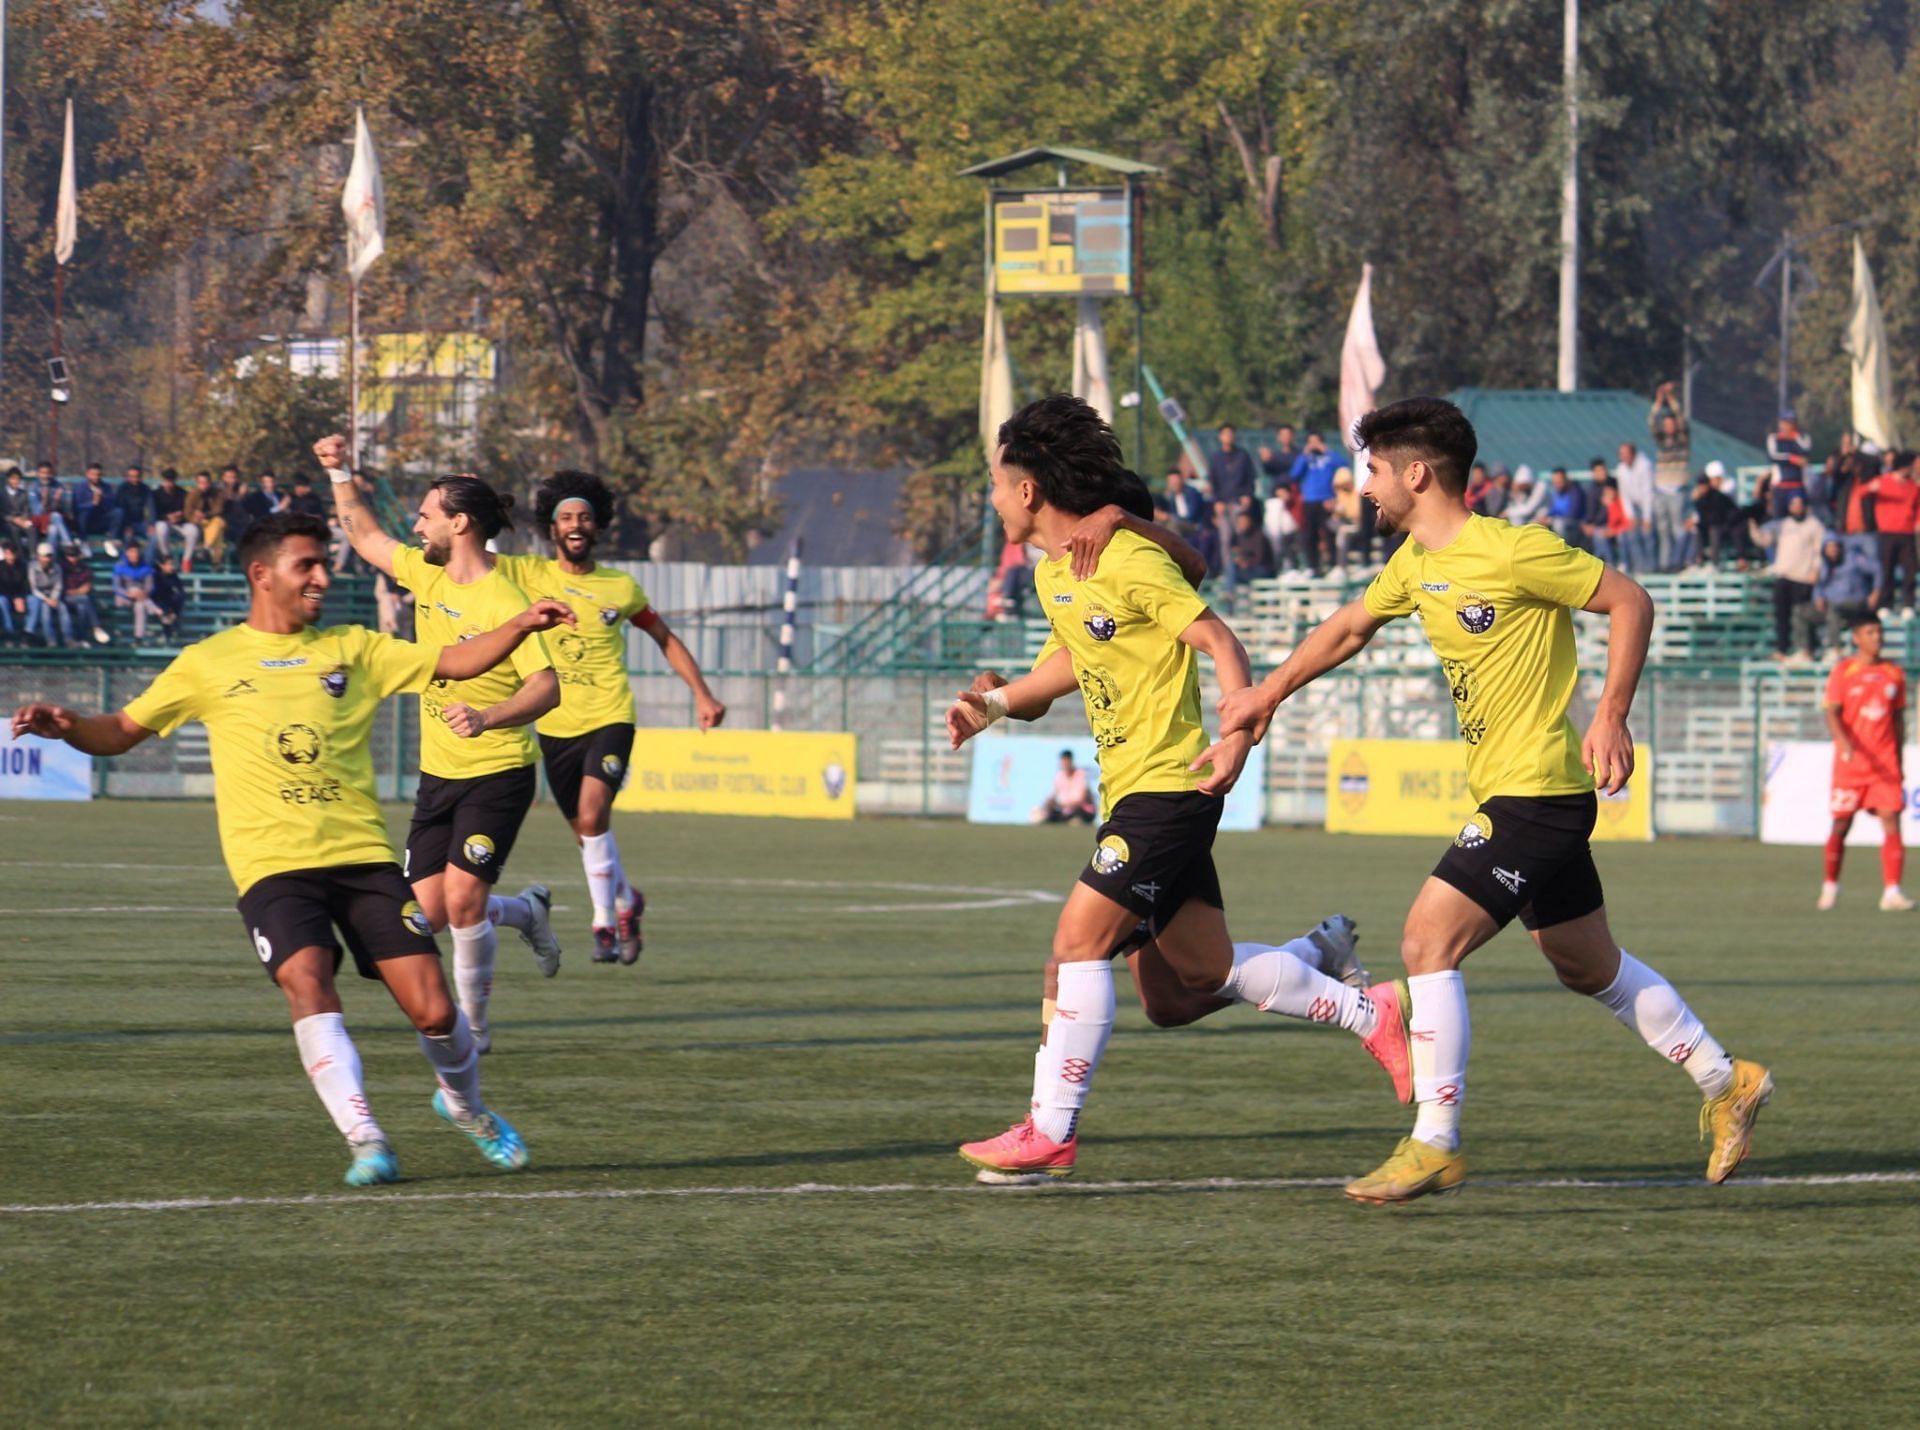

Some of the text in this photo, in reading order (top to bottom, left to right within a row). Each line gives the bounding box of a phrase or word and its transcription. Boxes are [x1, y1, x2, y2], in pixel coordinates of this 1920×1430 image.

[281, 785, 343, 805] PEACE
[1491, 867, 1521, 896] VECTOR
[253, 927, 273, 963] 6
